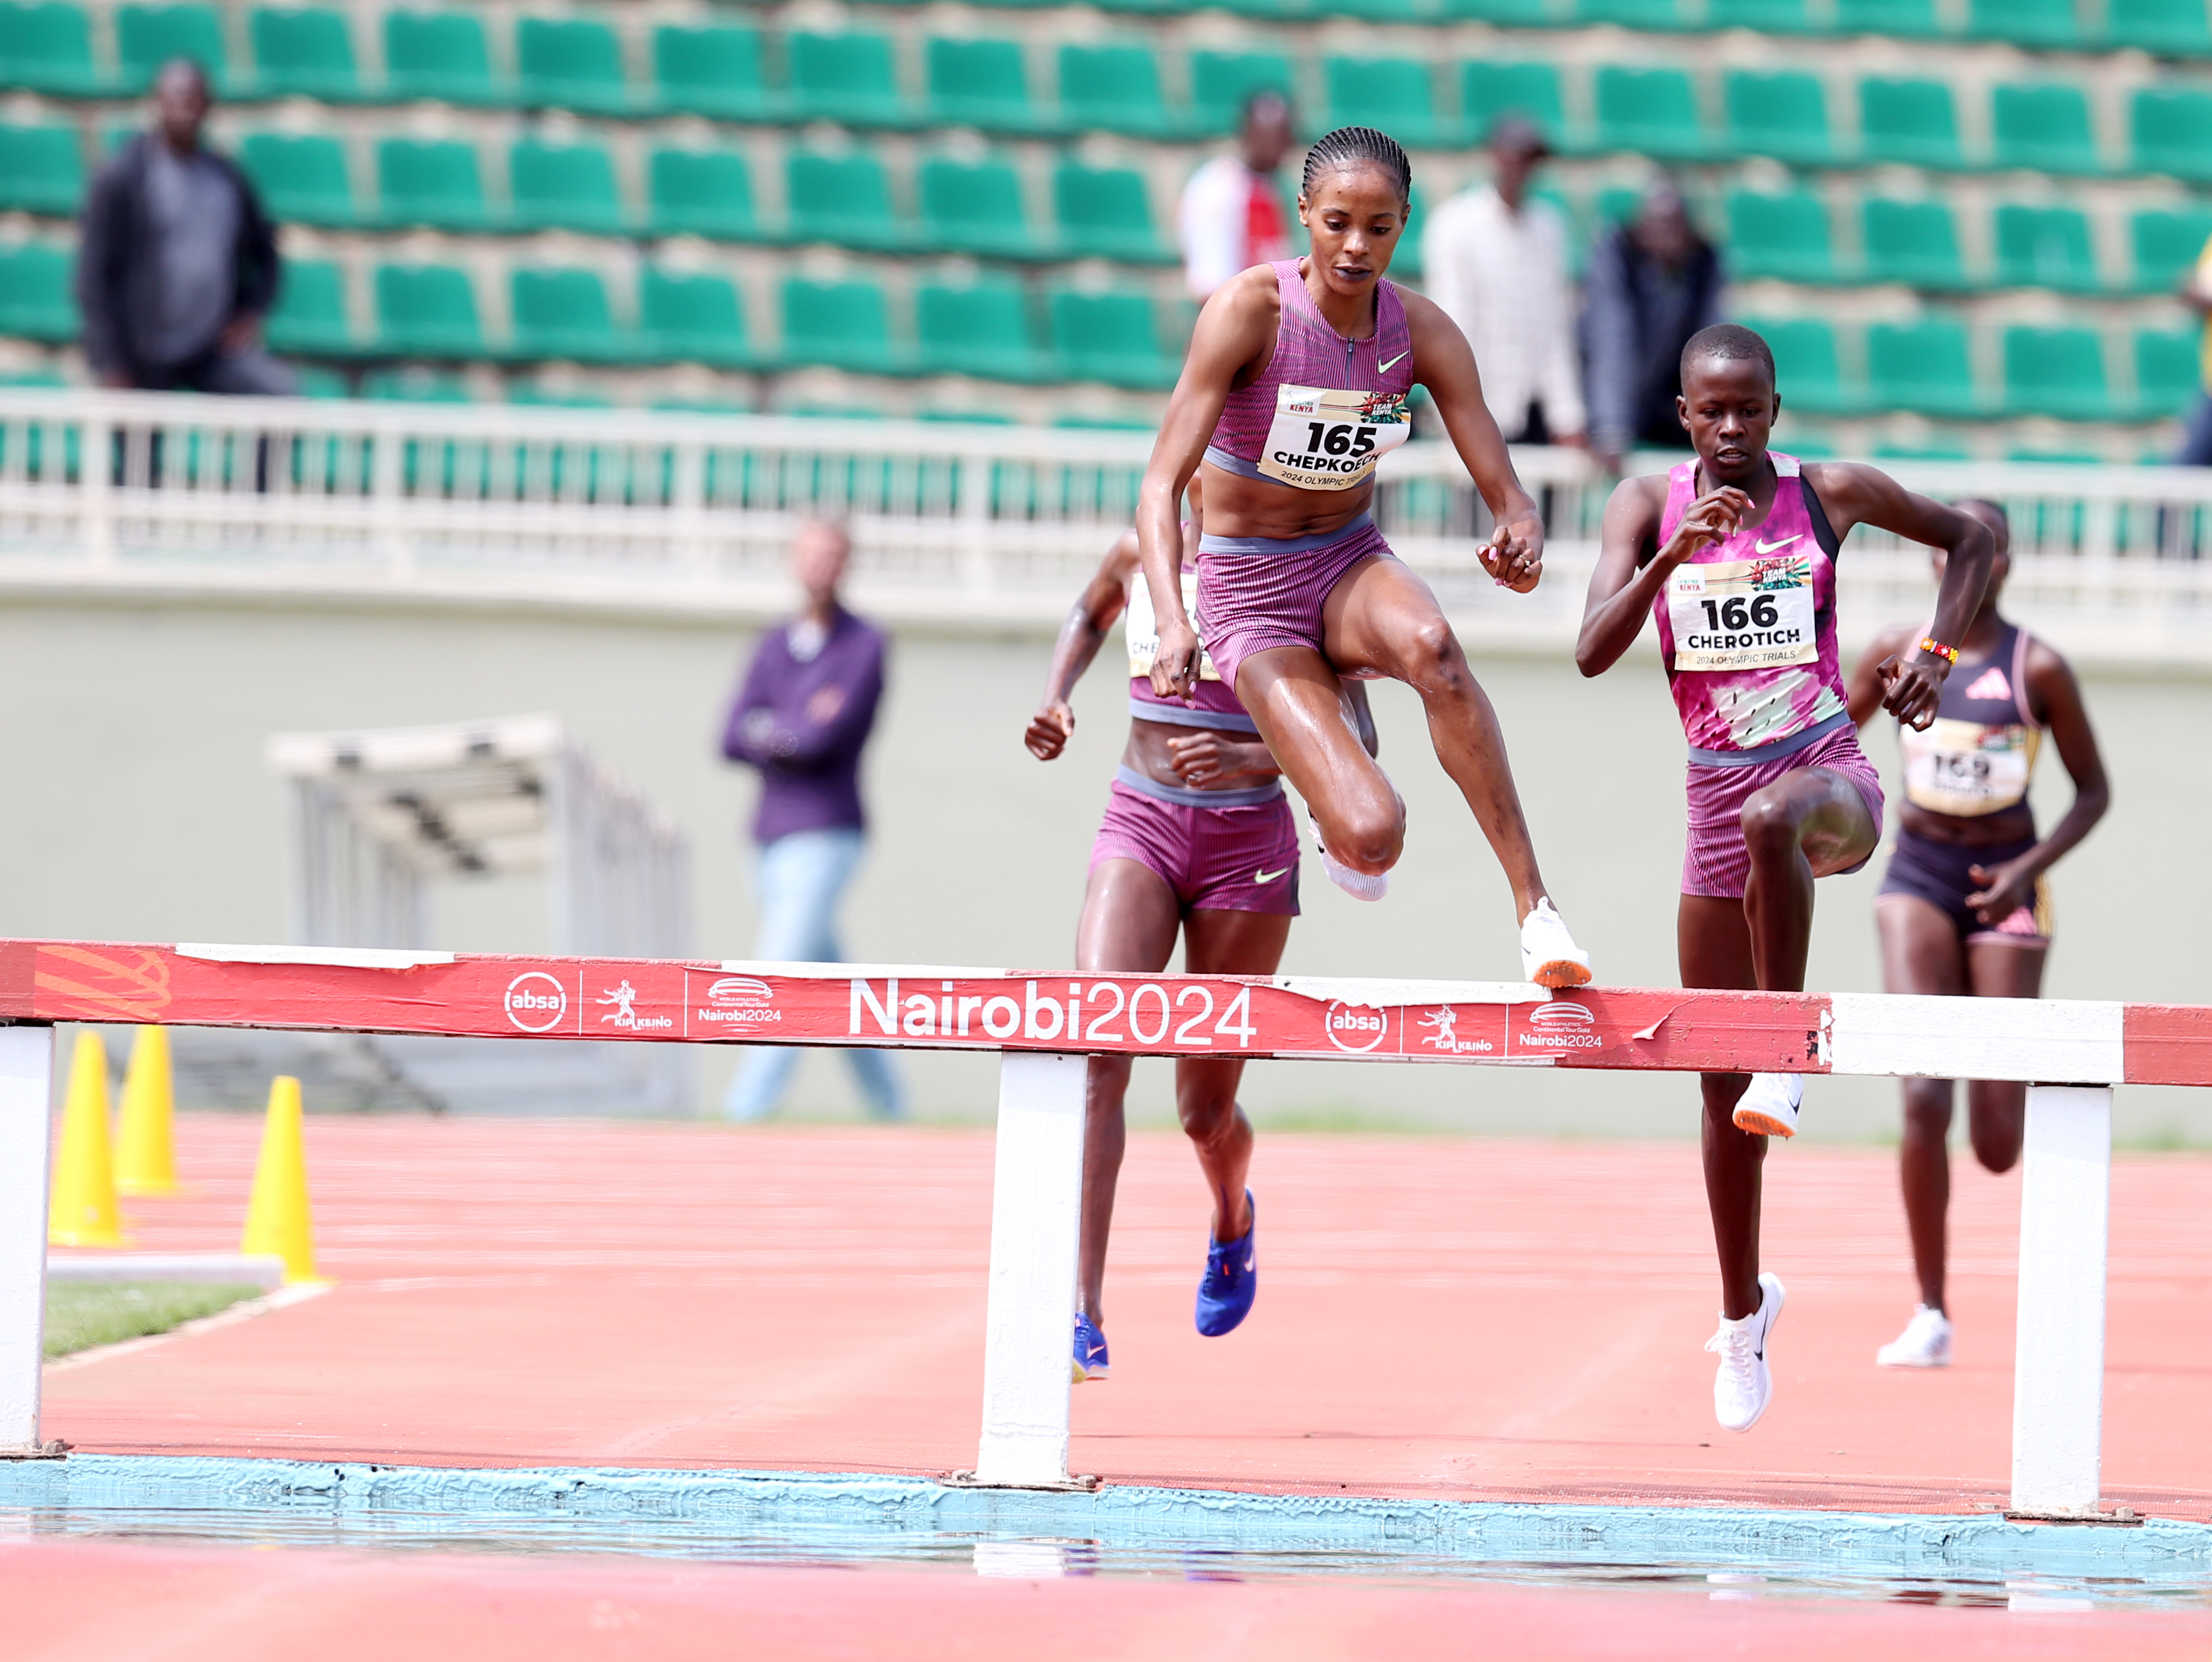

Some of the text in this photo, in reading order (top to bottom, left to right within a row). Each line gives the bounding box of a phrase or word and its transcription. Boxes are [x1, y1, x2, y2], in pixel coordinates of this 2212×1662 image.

[1289, 404, 1313, 413] KENYA
[1307, 422, 1377, 458] 165
[1274, 451, 1382, 473] CHEPKOECH
[1281, 471, 1303, 482] 2024
[1304, 476, 1345, 486] OLYMPIC
[1762, 567, 1786, 577] TEAM
[1763, 574, 1787, 583] KENYA
[1701, 594, 1778, 631] 166
[1688, 629, 1800, 649] CHEROTICH
[1697, 650, 1796, 664] 2024 OLYMPIC TRIALS
[512, 989, 559, 1009] absa
[698, 1009, 782, 1022] Nairobi2024
[849, 978, 1256, 1048] Nairobi2024
[1333, 1010, 1380, 1030] absa
[614, 1015, 673, 1027] KIP KEINO
[1458, 1039, 1493, 1051] KEINO
[1519, 1034, 1602, 1047] Nairobi2024
